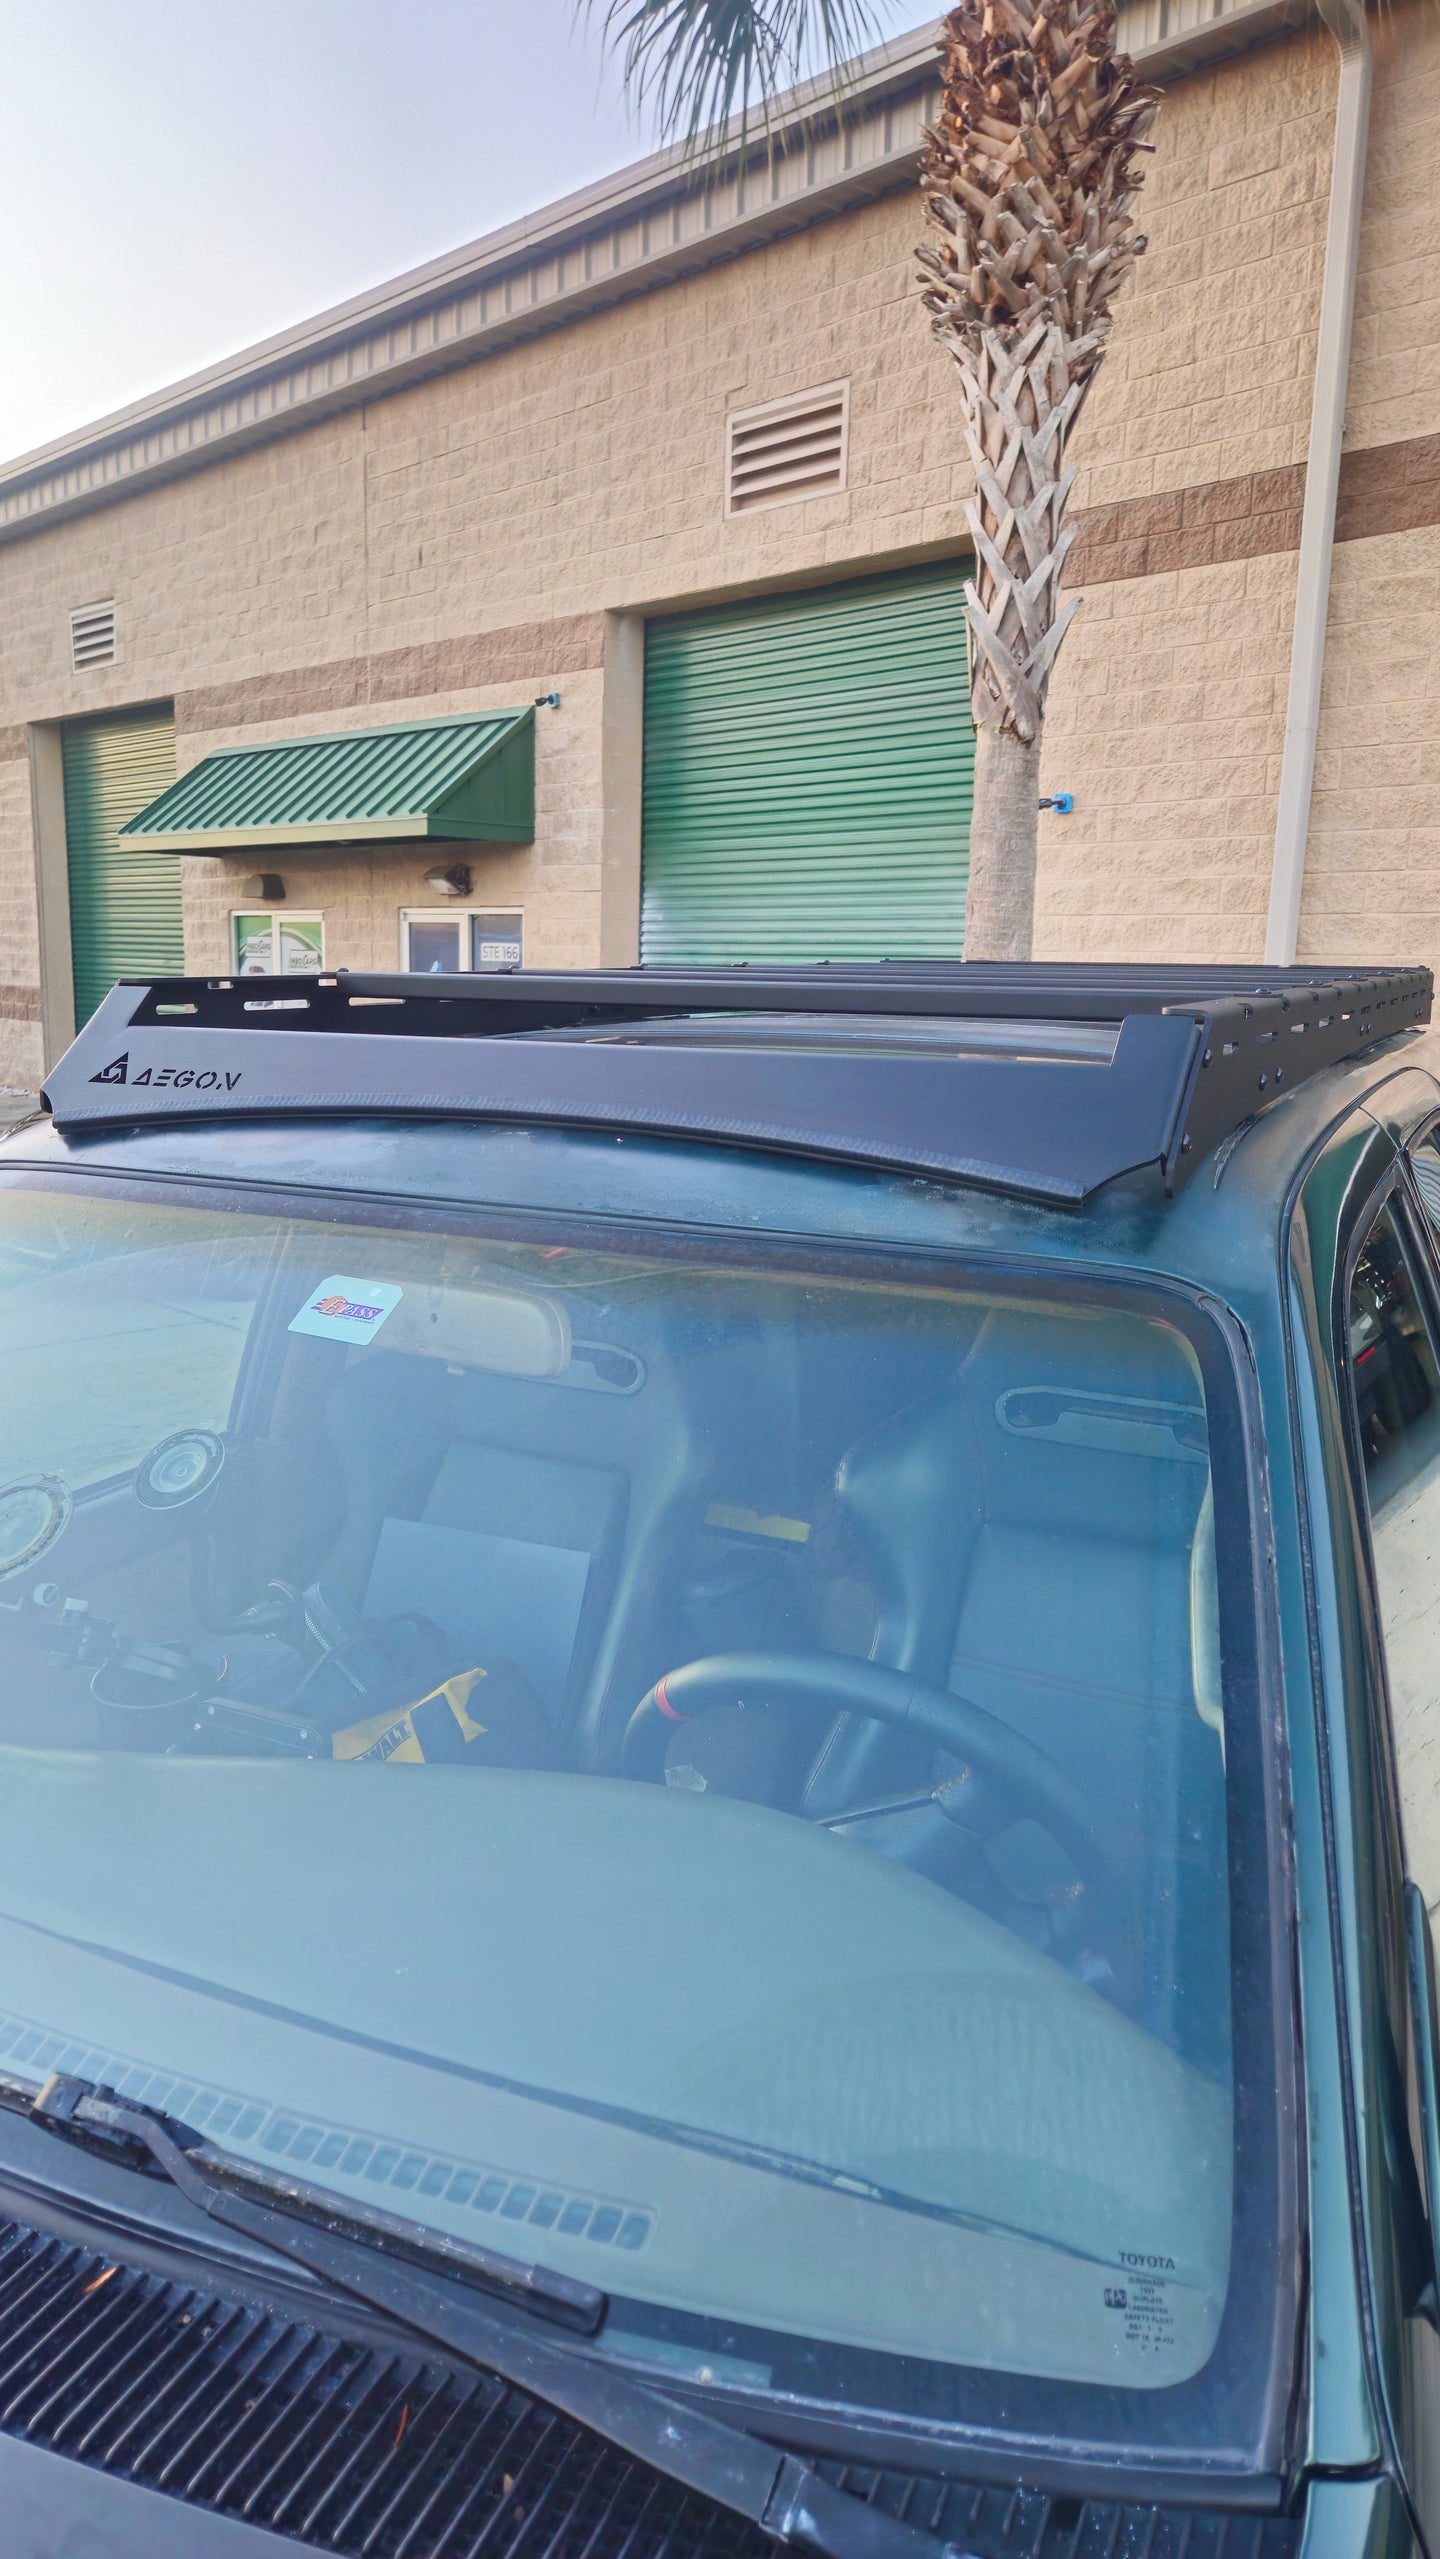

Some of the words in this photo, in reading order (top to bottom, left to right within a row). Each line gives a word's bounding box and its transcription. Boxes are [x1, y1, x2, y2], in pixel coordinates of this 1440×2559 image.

[482, 945, 500, 959] STE
[501, 945, 518, 959] 166
[131, 1067, 242, 1090] AEGON
[1118, 2251, 1175, 2270] TOYOTA
